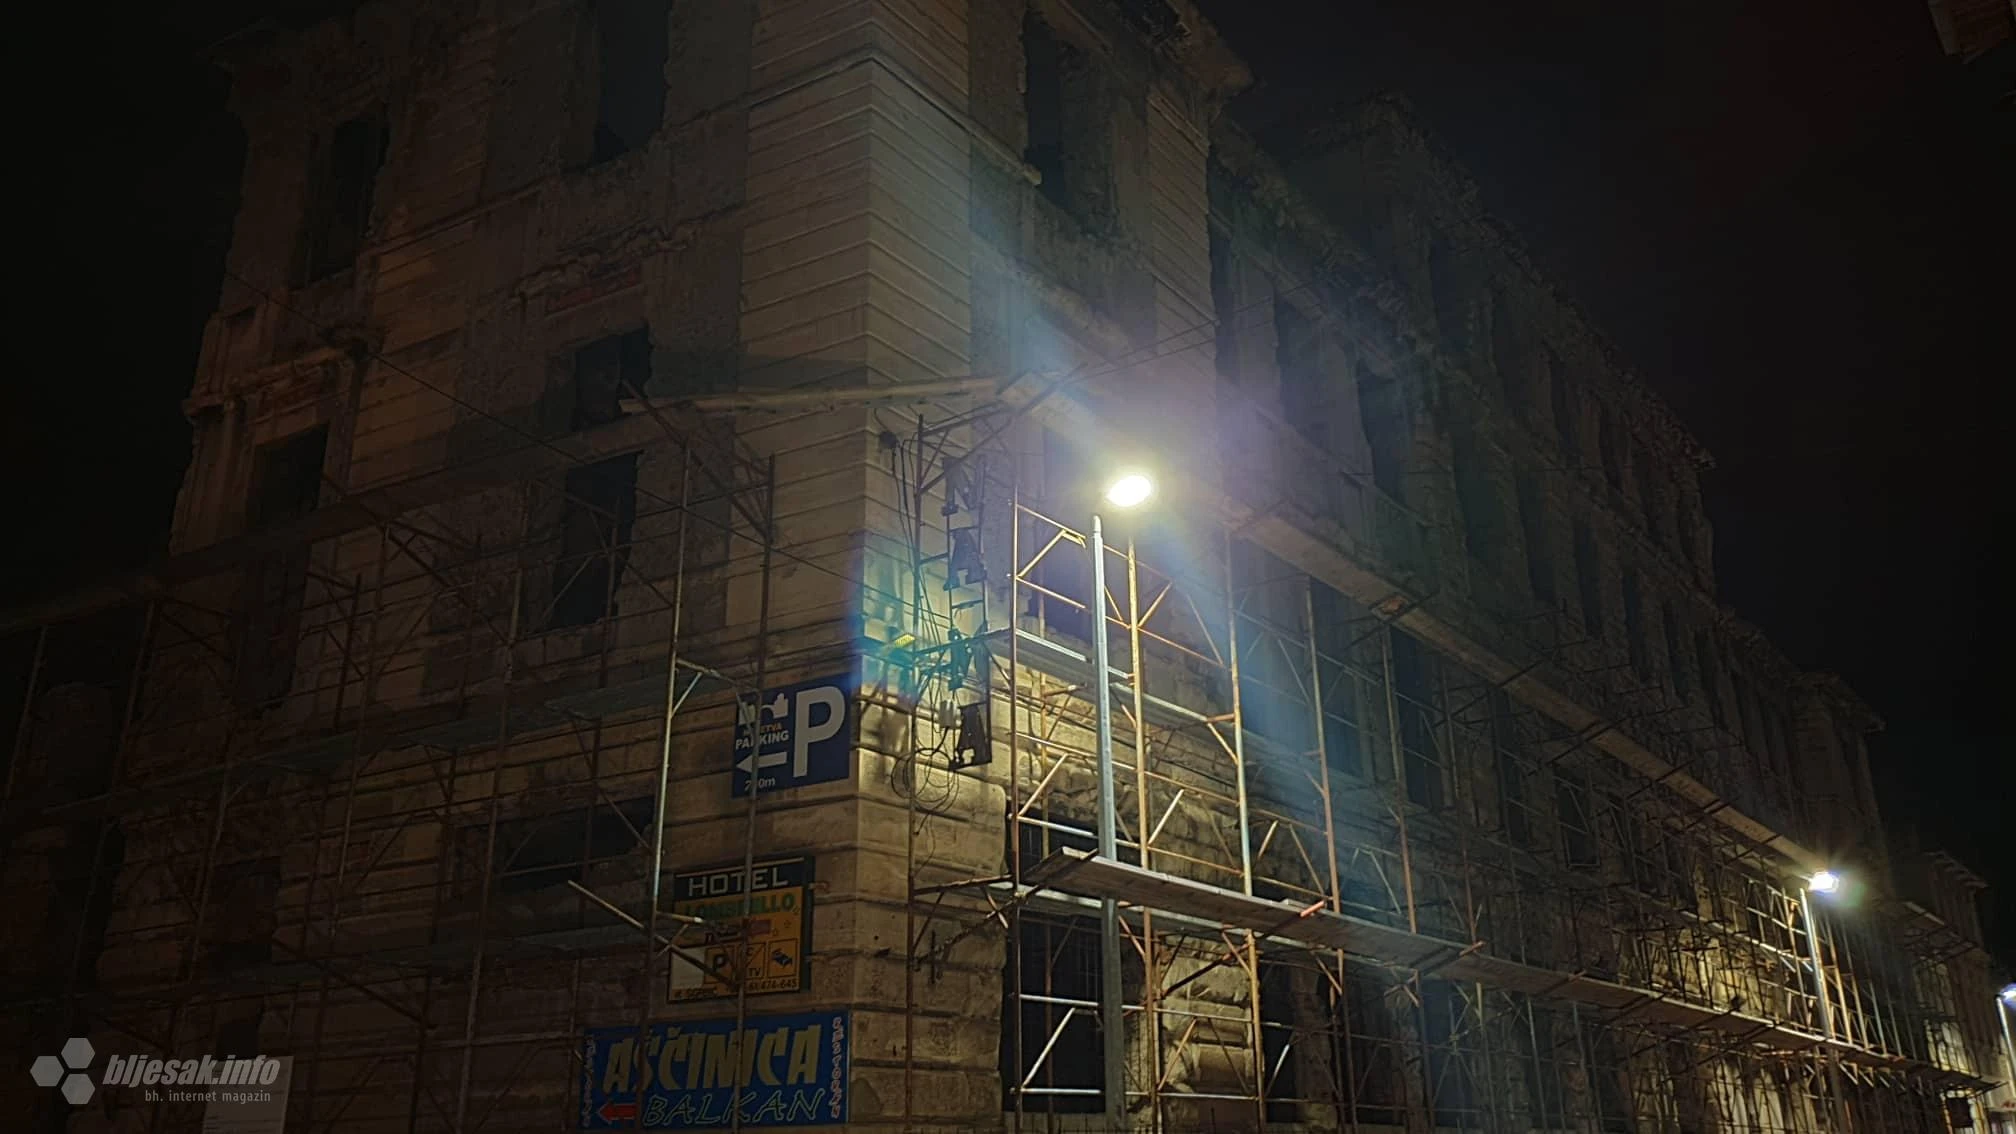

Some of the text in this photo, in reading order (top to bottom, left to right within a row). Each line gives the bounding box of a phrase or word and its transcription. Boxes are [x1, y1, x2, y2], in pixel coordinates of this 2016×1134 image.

[793, 686, 846, 778] P
[688, 867, 789, 897] HOTEL
[642, 1088, 826, 1127] BALKAN
